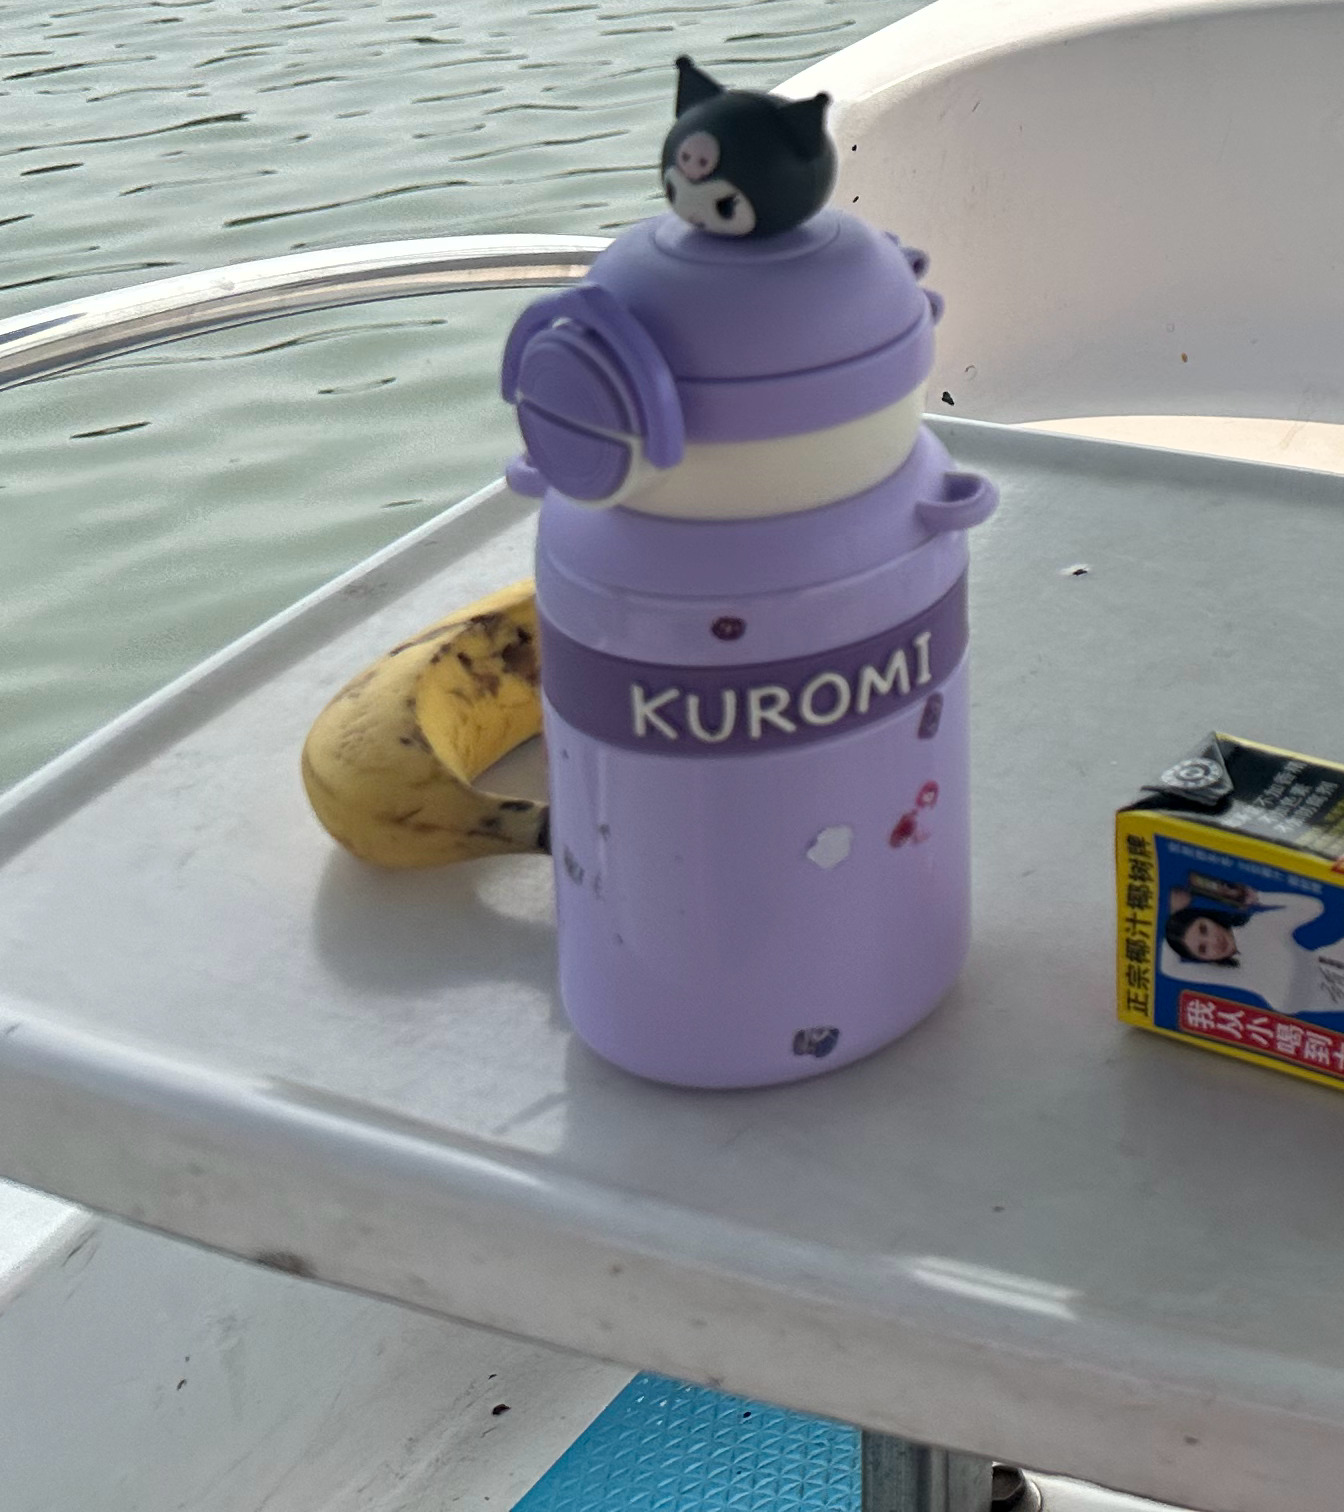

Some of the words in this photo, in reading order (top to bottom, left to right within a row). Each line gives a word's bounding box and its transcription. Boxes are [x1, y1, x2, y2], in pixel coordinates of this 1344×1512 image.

[630, 630, 934, 743] KUROMI
[1125, 834, 1153, 1017] 正宗椰汁椰树牌
